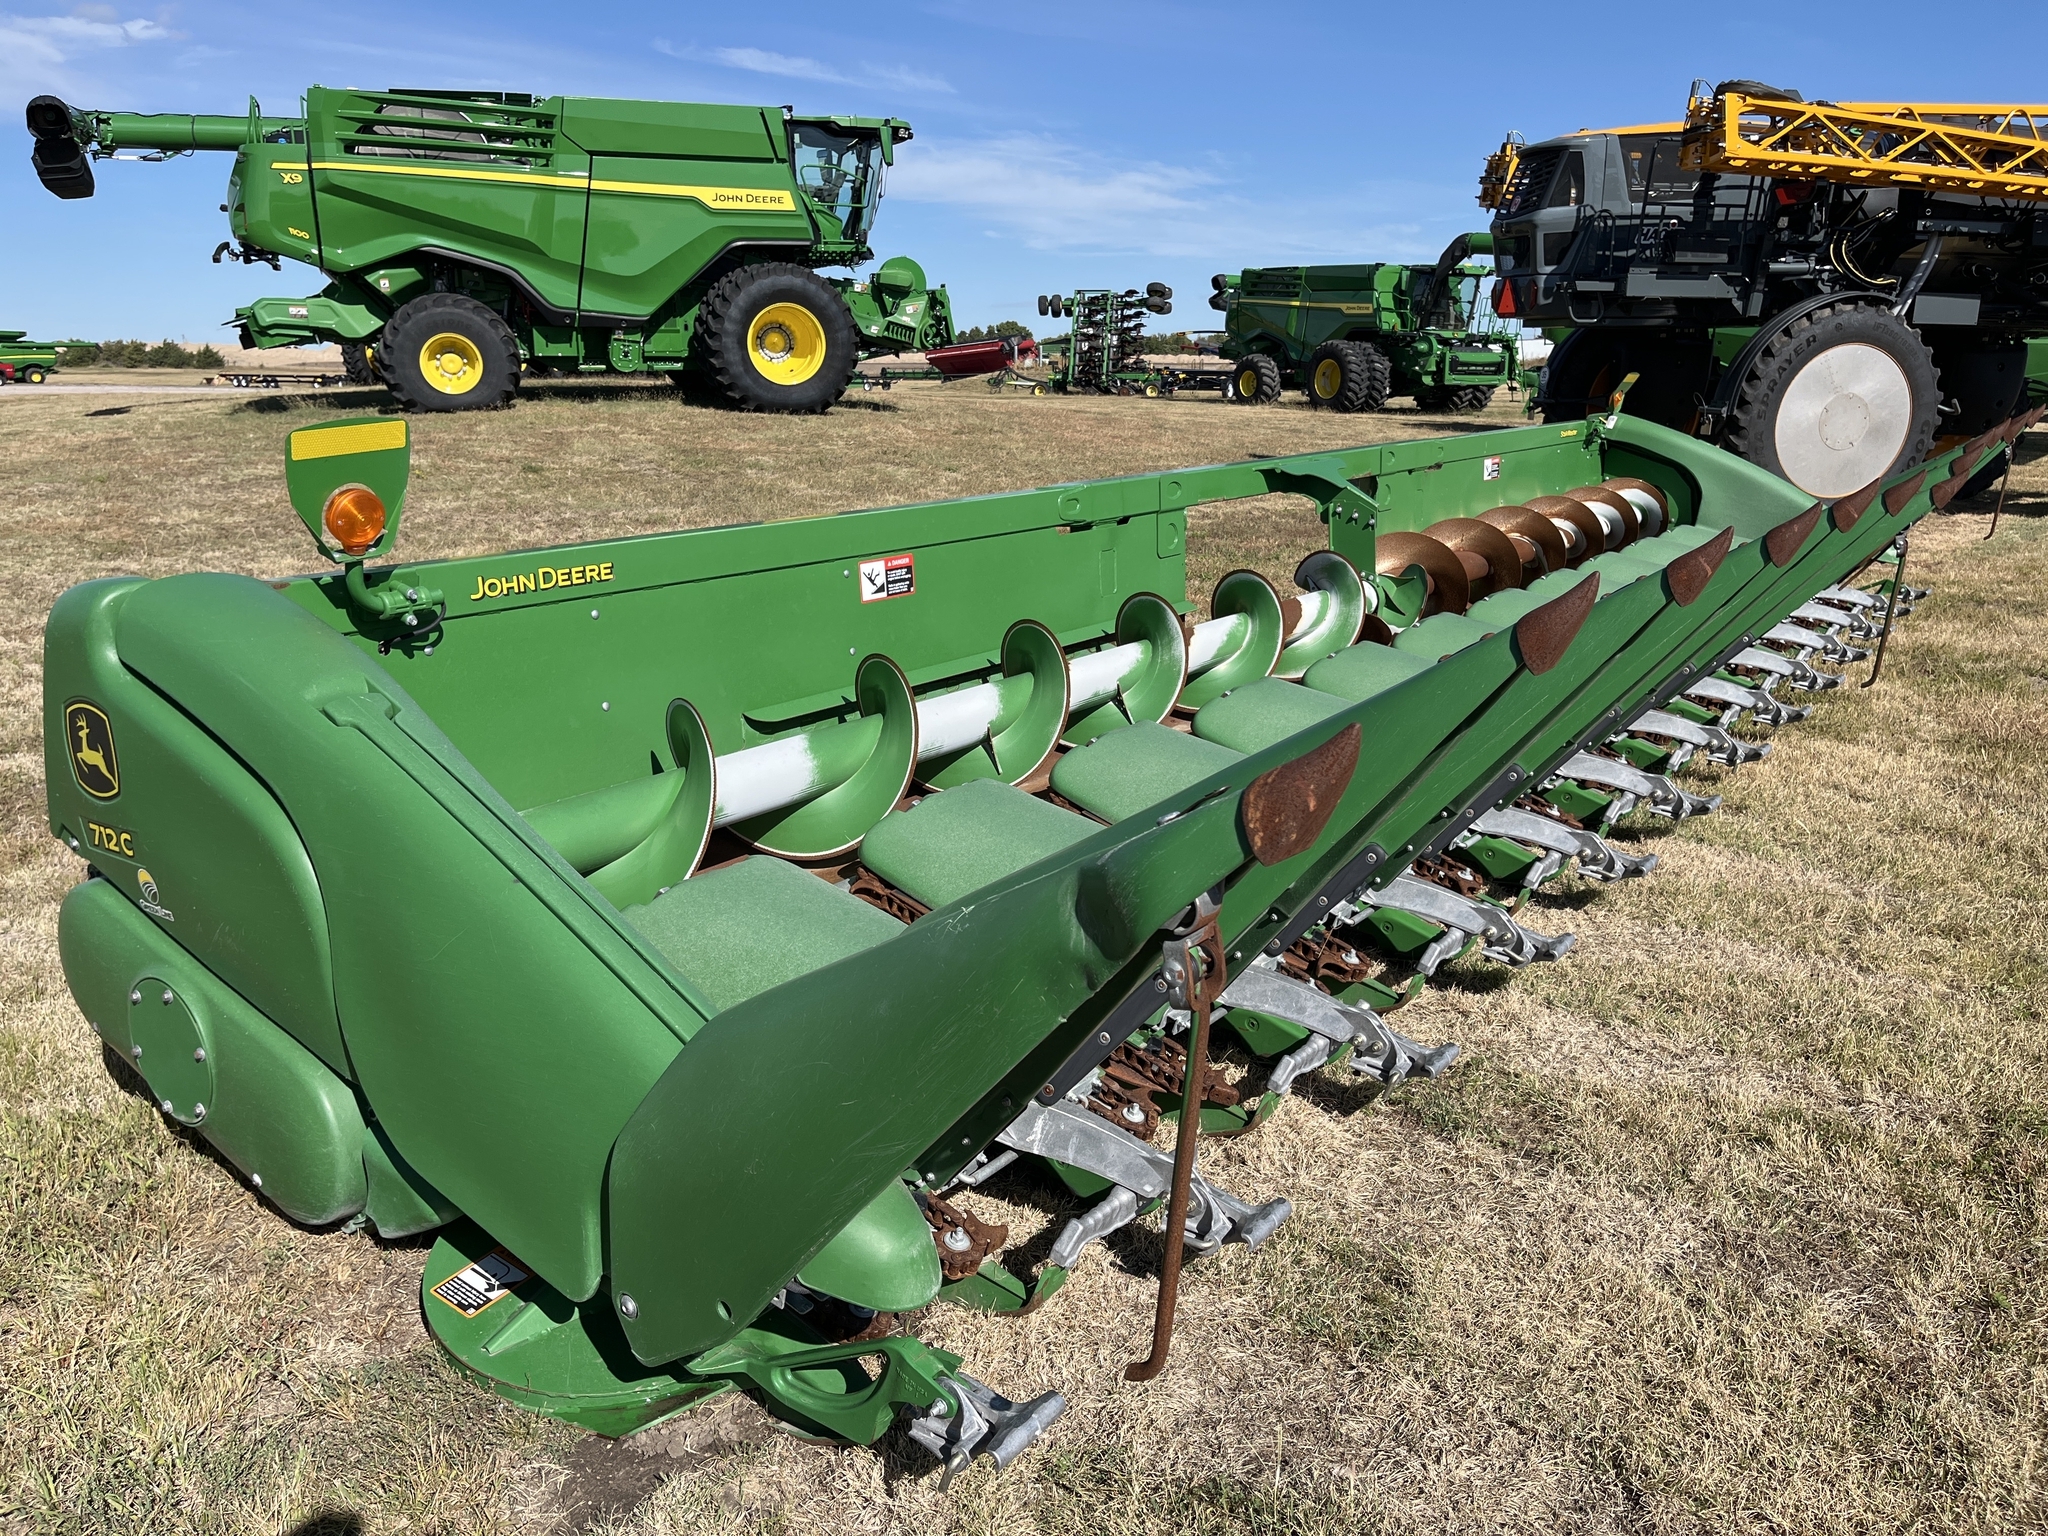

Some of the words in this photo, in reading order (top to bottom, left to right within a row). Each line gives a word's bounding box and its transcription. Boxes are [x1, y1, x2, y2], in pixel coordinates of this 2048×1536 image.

[279, 172, 303, 184] X9
[712, 193, 743, 202] JOHN
[746, 194, 784, 204] DEERE
[287, 226, 310, 240] 1100
[1757, 334, 1817, 420] SPRAYER
[892, 557, 910, 566] DANGER
[470, 573, 537, 600] JOHN
[537, 562, 615, 590] DEERE
[88, 822, 134, 857] 712C
